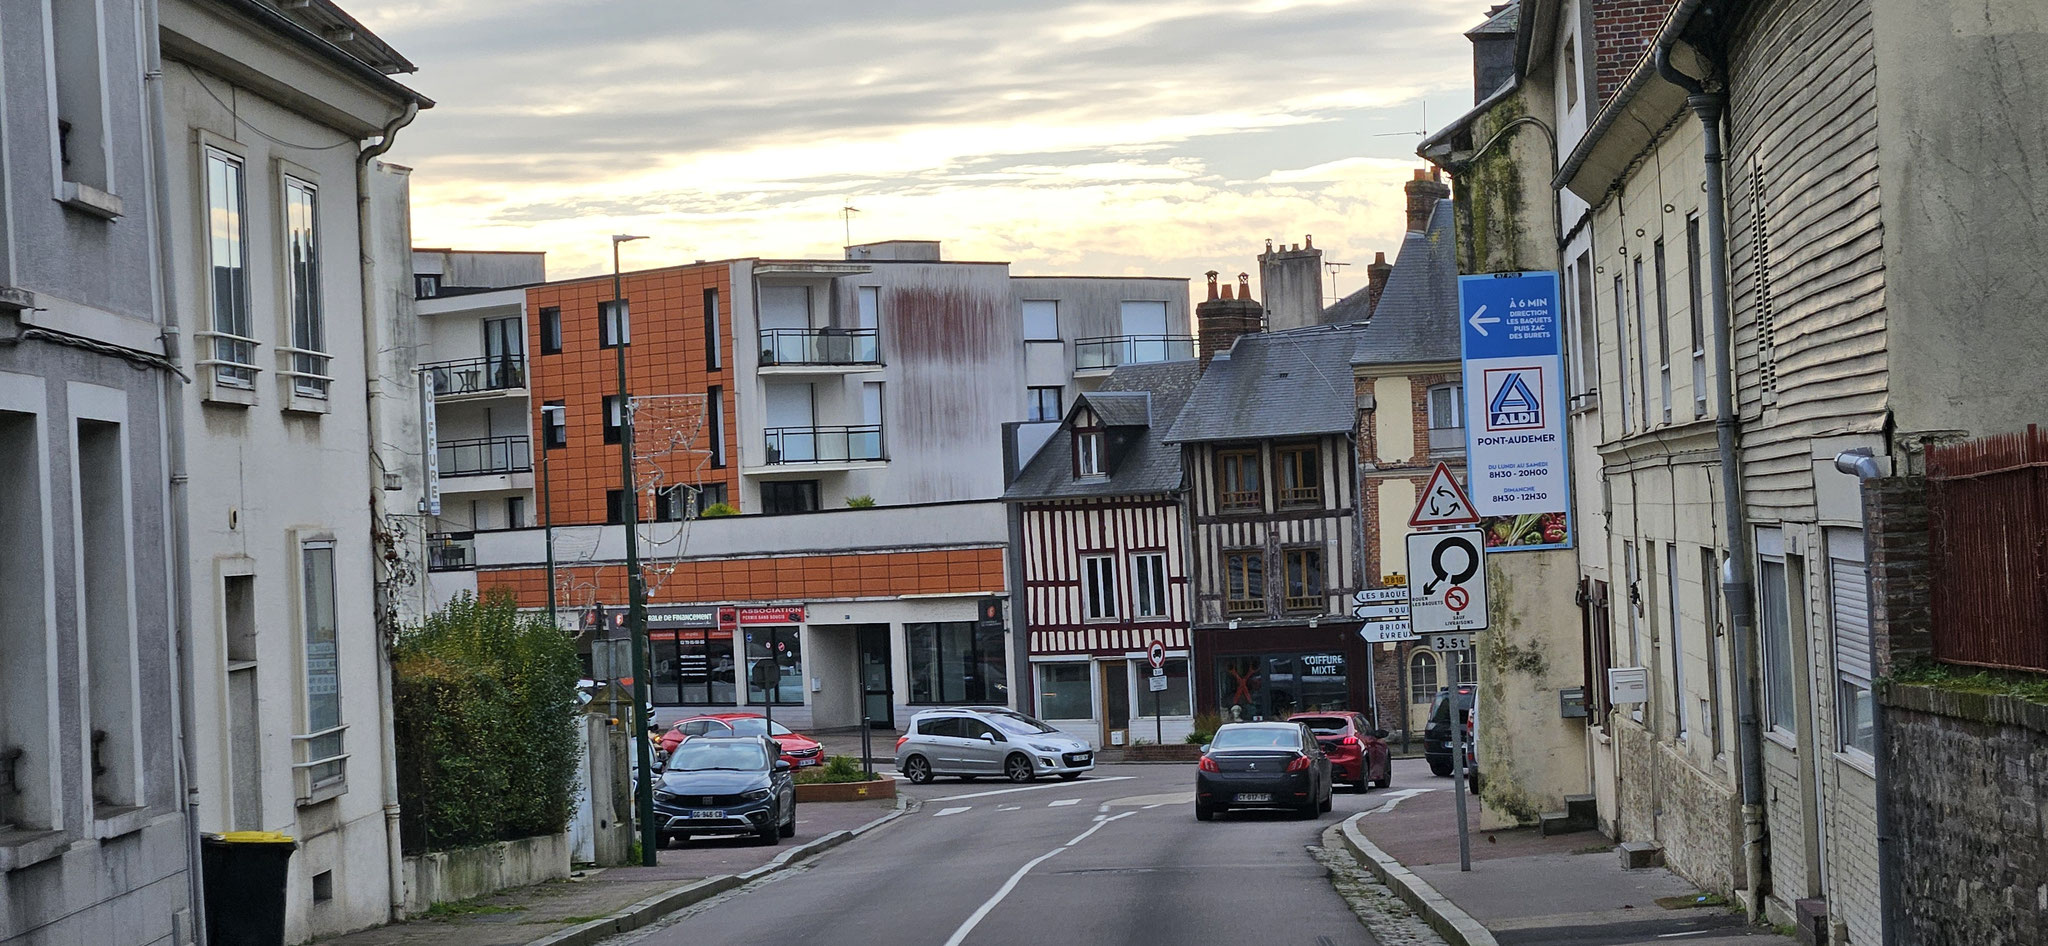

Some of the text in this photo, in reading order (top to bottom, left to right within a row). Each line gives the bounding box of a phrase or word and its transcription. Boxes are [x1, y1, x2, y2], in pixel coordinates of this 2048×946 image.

[1509, 297, 1548, 308] À 6 MIN
[1506, 316, 1552, 325] LES BAQUETS
[1509, 331, 1551, 340] DES BURETS
[1496, 412, 1536, 425] ALDI
[425, 374, 438, 498] COIFFURE
[1477, 434, 1556, 446] PONT-AUDEMER
[1489, 470, 1512, 479] 8H30
[1518, 469, 1548, 477] 20H00
[1492, 494, 1515, 502] 8H30
[1521, 493, 1548, 501] 12H30
[1361, 590, 1407, 600] LES BAQUE
[647, 614, 663, 622] RALE
[672, 613, 712, 621] FINANCEMENT
[1379, 622, 1410, 631] BRION
[1304, 655, 1343, 665] COIFFURE
[1311, 665, 1337, 675] MIXTE
